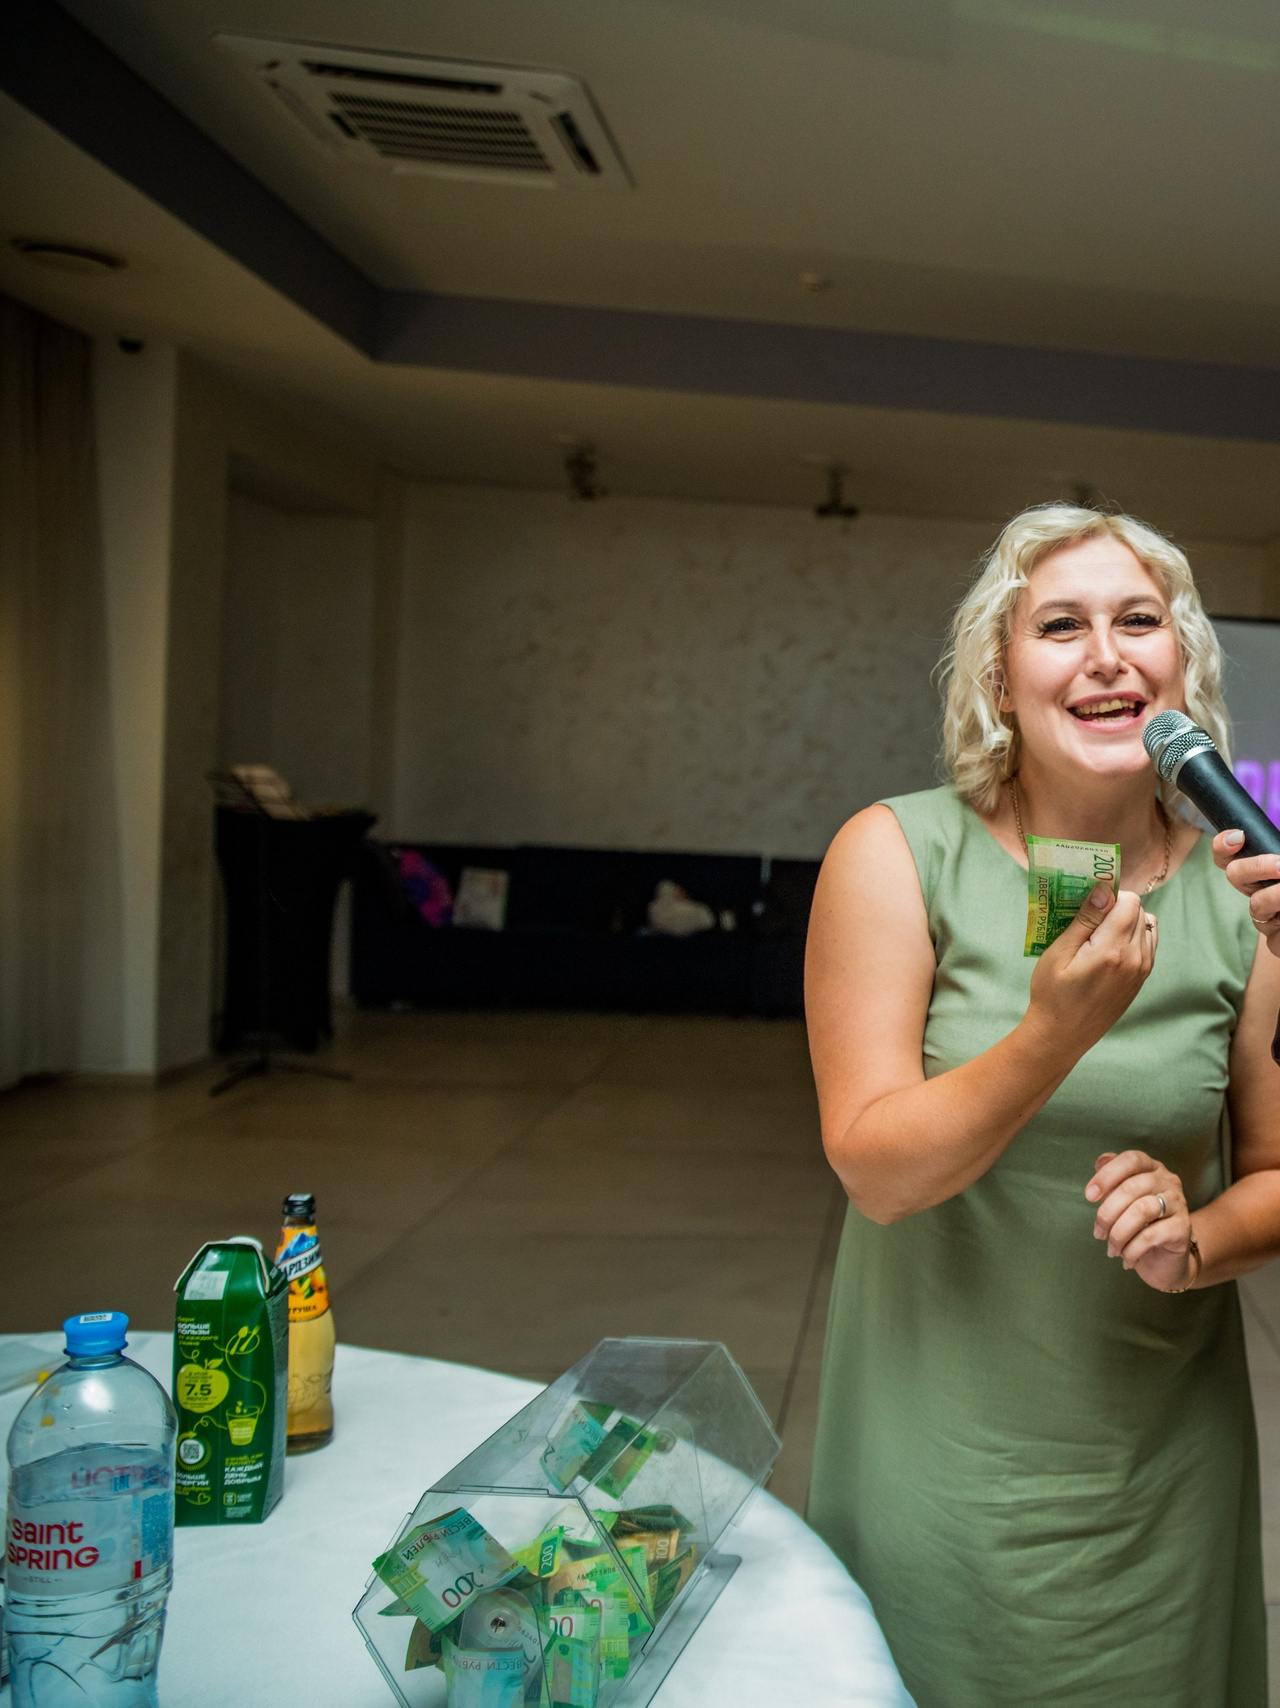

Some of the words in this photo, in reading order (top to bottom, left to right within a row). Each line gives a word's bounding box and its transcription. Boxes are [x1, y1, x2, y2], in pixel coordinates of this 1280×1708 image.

[1093, 853, 1115, 882] 200
[1037, 876, 1048, 914] ДВЕСТИ
[289, 1305, 317, 1314] РУША
[184, 1383, 212, 1396] 7.5
[541, 1545, 554, 1570] 200
[656, 1539, 669, 1560] 100
[441, 1572, 484, 1608] 200
